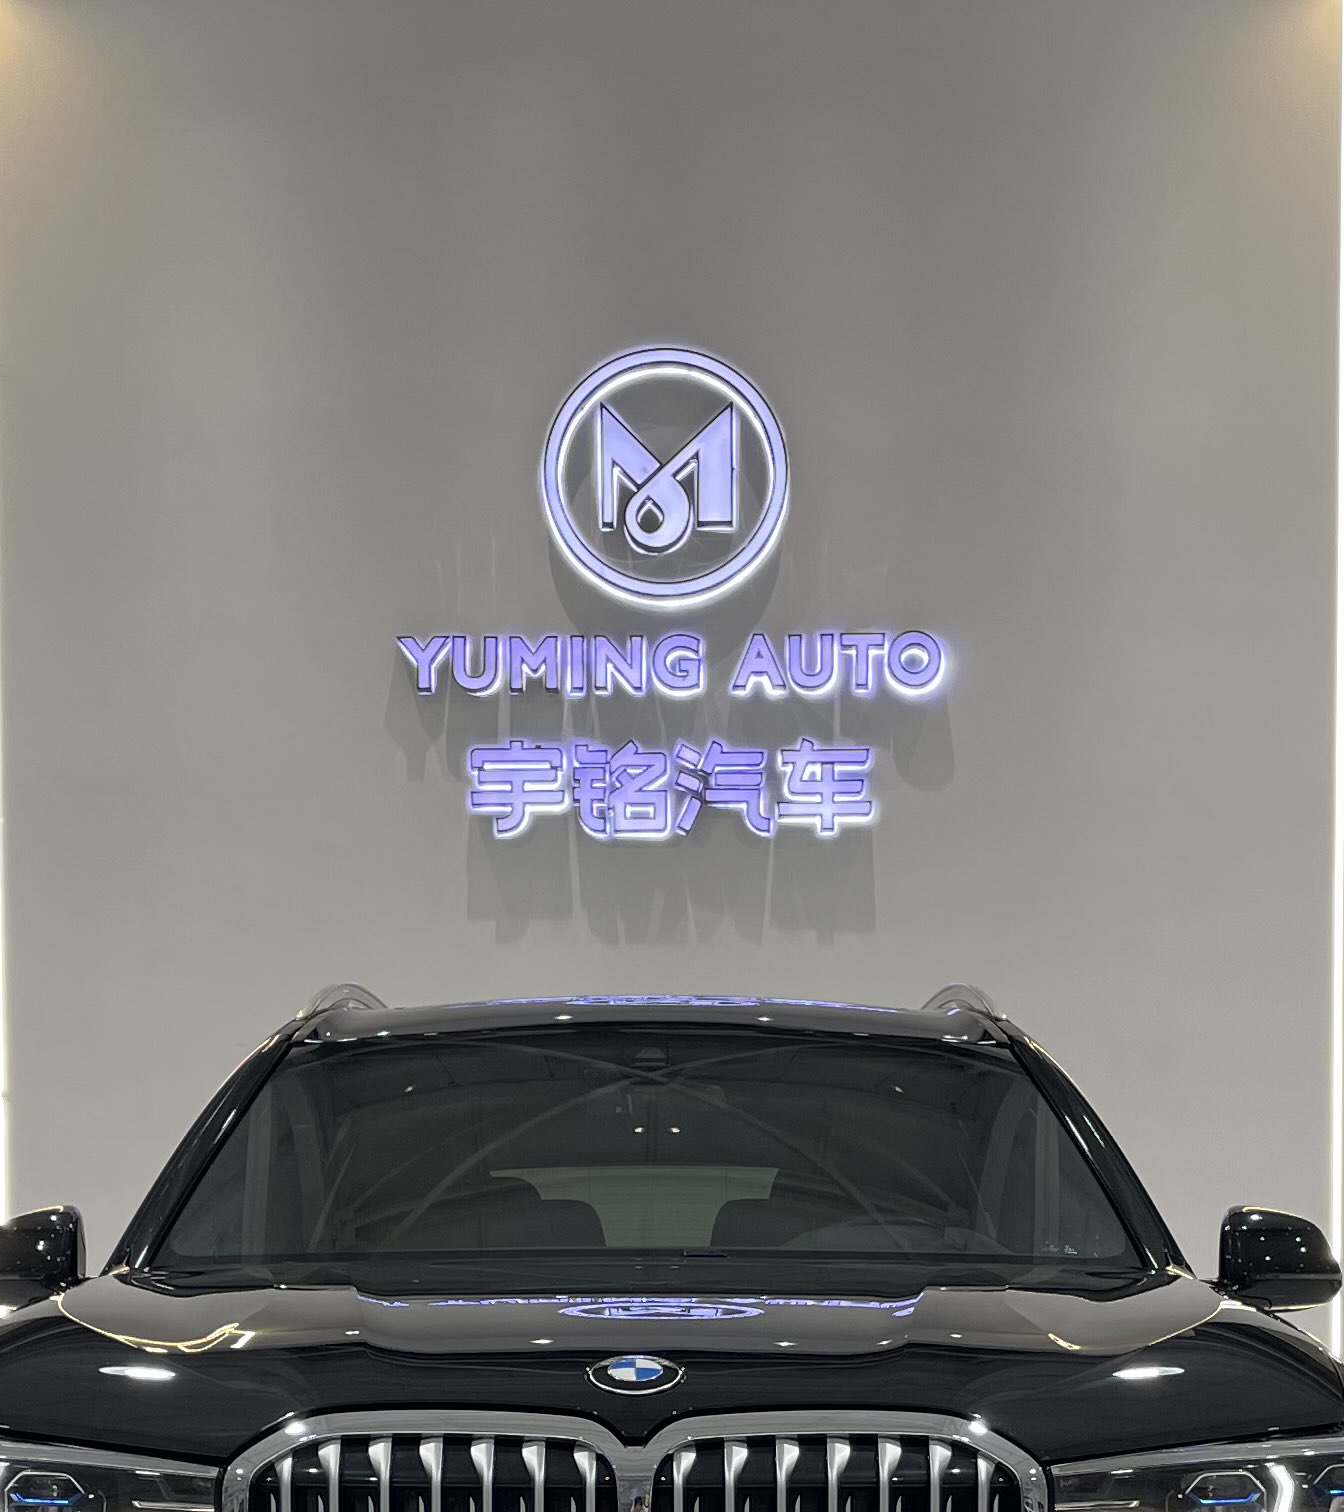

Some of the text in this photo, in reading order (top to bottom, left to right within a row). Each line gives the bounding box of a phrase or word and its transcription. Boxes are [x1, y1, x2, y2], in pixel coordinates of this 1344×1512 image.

[396, 628, 947, 697] YUMING AUTO
[466, 736, 877, 840] 宇铭汽车
